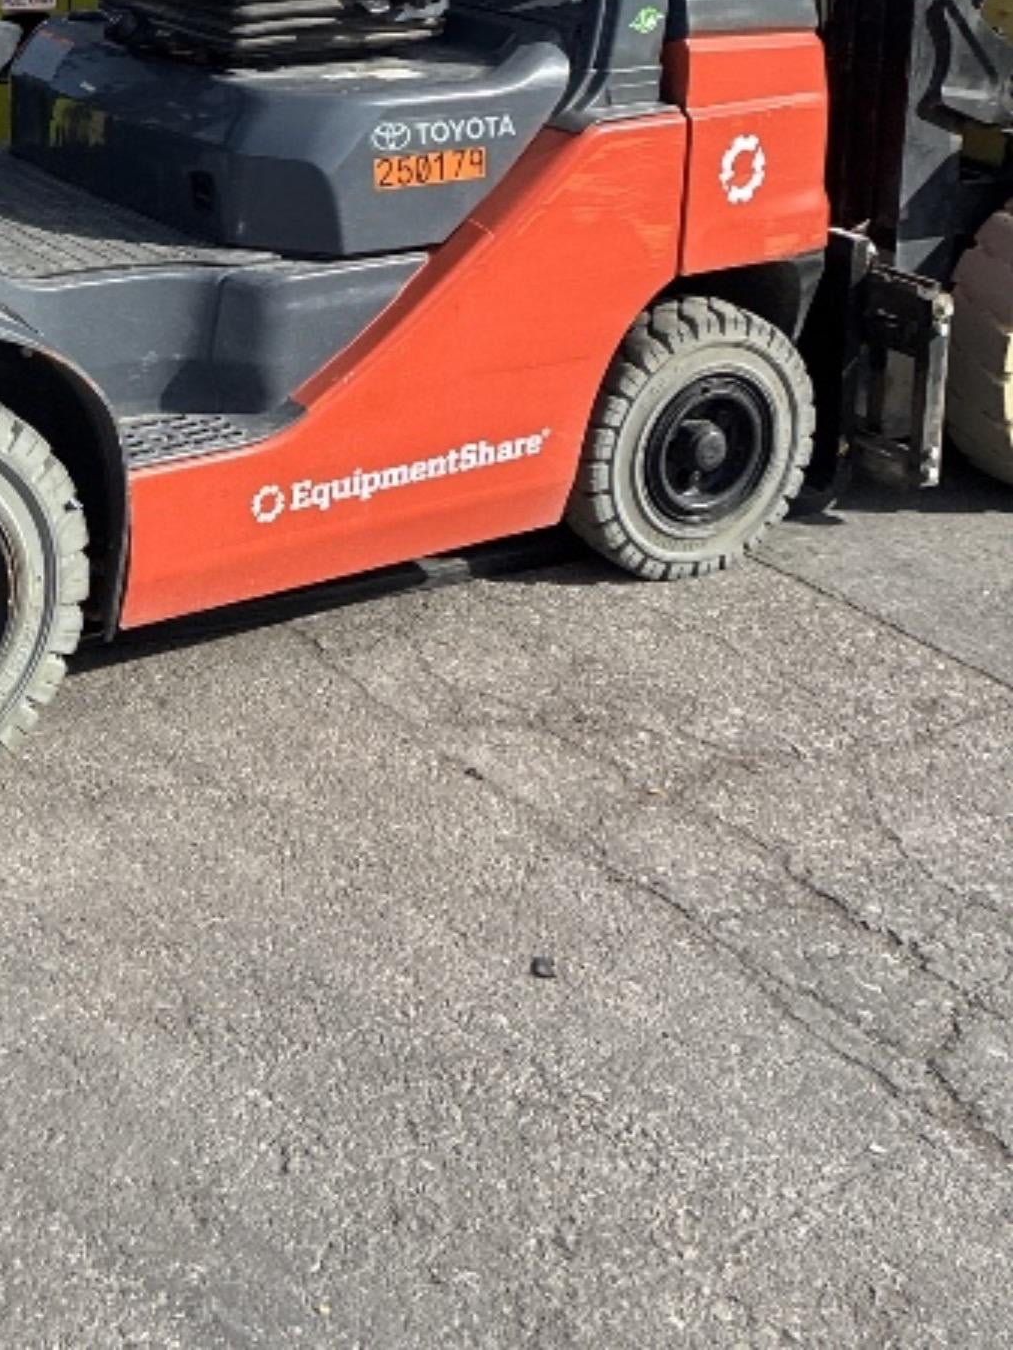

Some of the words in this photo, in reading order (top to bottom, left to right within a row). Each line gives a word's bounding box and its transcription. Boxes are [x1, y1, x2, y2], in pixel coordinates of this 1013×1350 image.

[414, 113, 517, 146] TOYOTA
[375, 148, 484, 187] 250179
[289, 432, 544, 511] EquipmentShare
